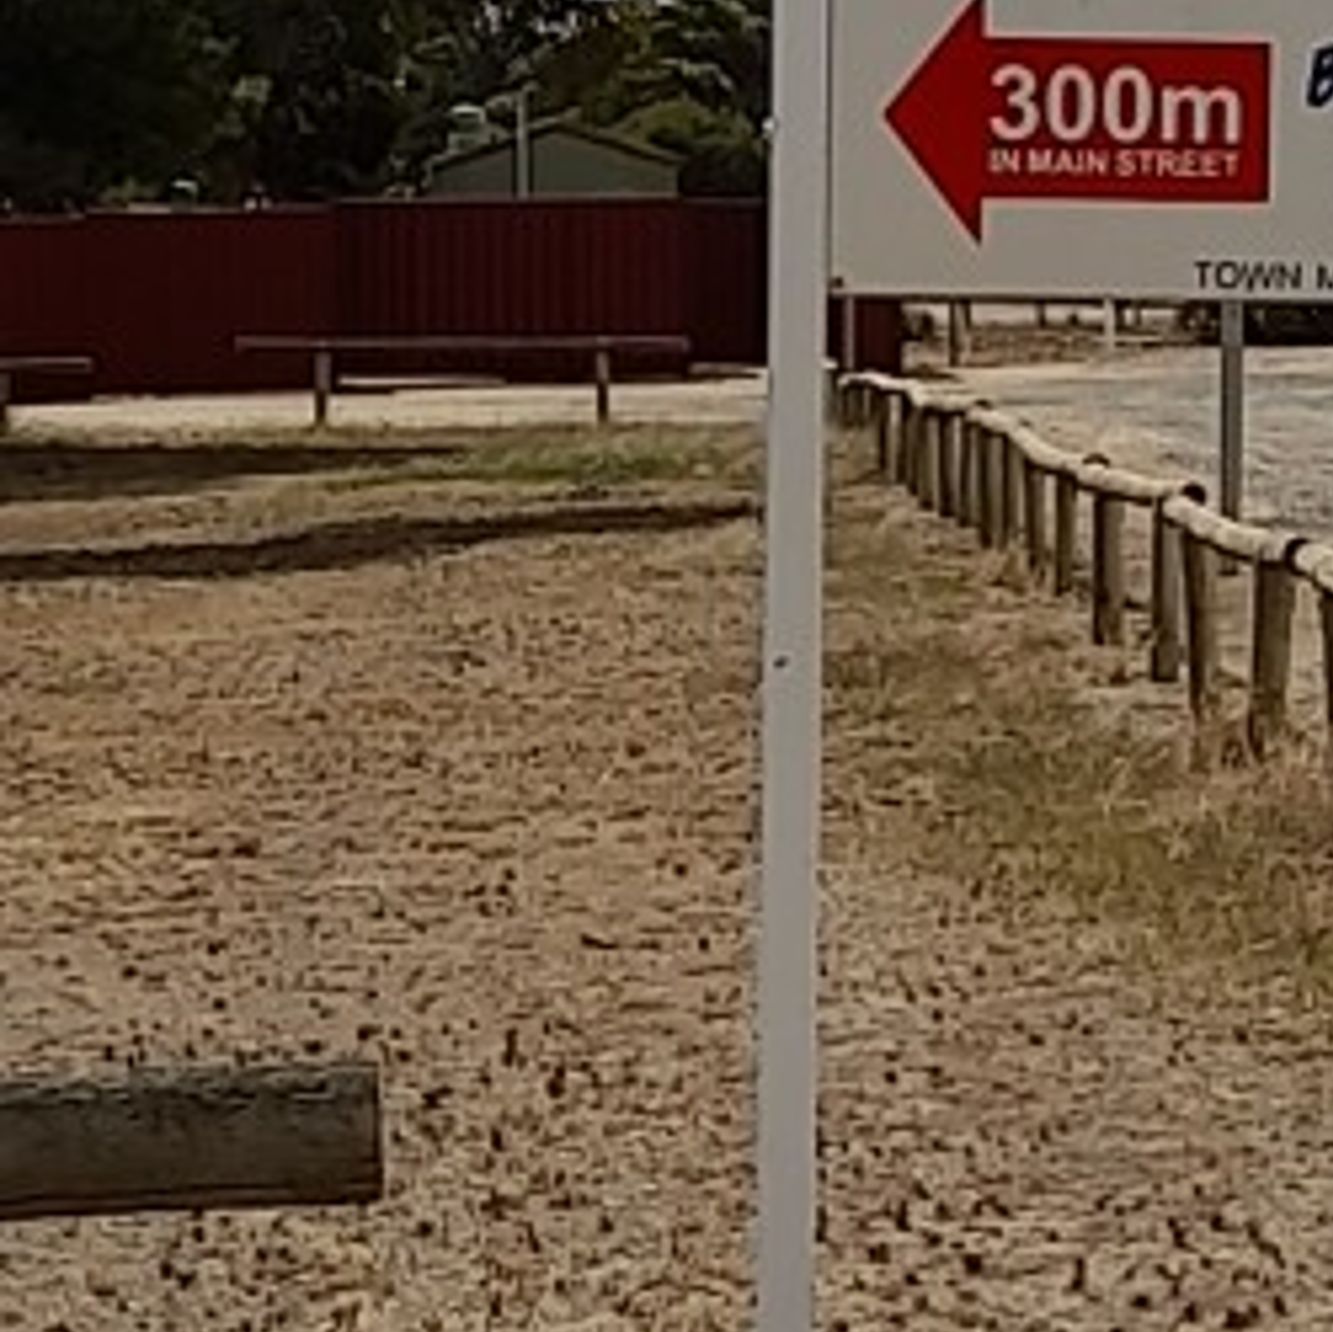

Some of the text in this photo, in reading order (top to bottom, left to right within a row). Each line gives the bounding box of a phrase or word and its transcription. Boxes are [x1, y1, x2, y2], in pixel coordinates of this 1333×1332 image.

[989, 64, 1242, 144] 300m
[988, 150, 1239, 177] IN MAIN STREET
[1194, 261, 1300, 291] TOWN
